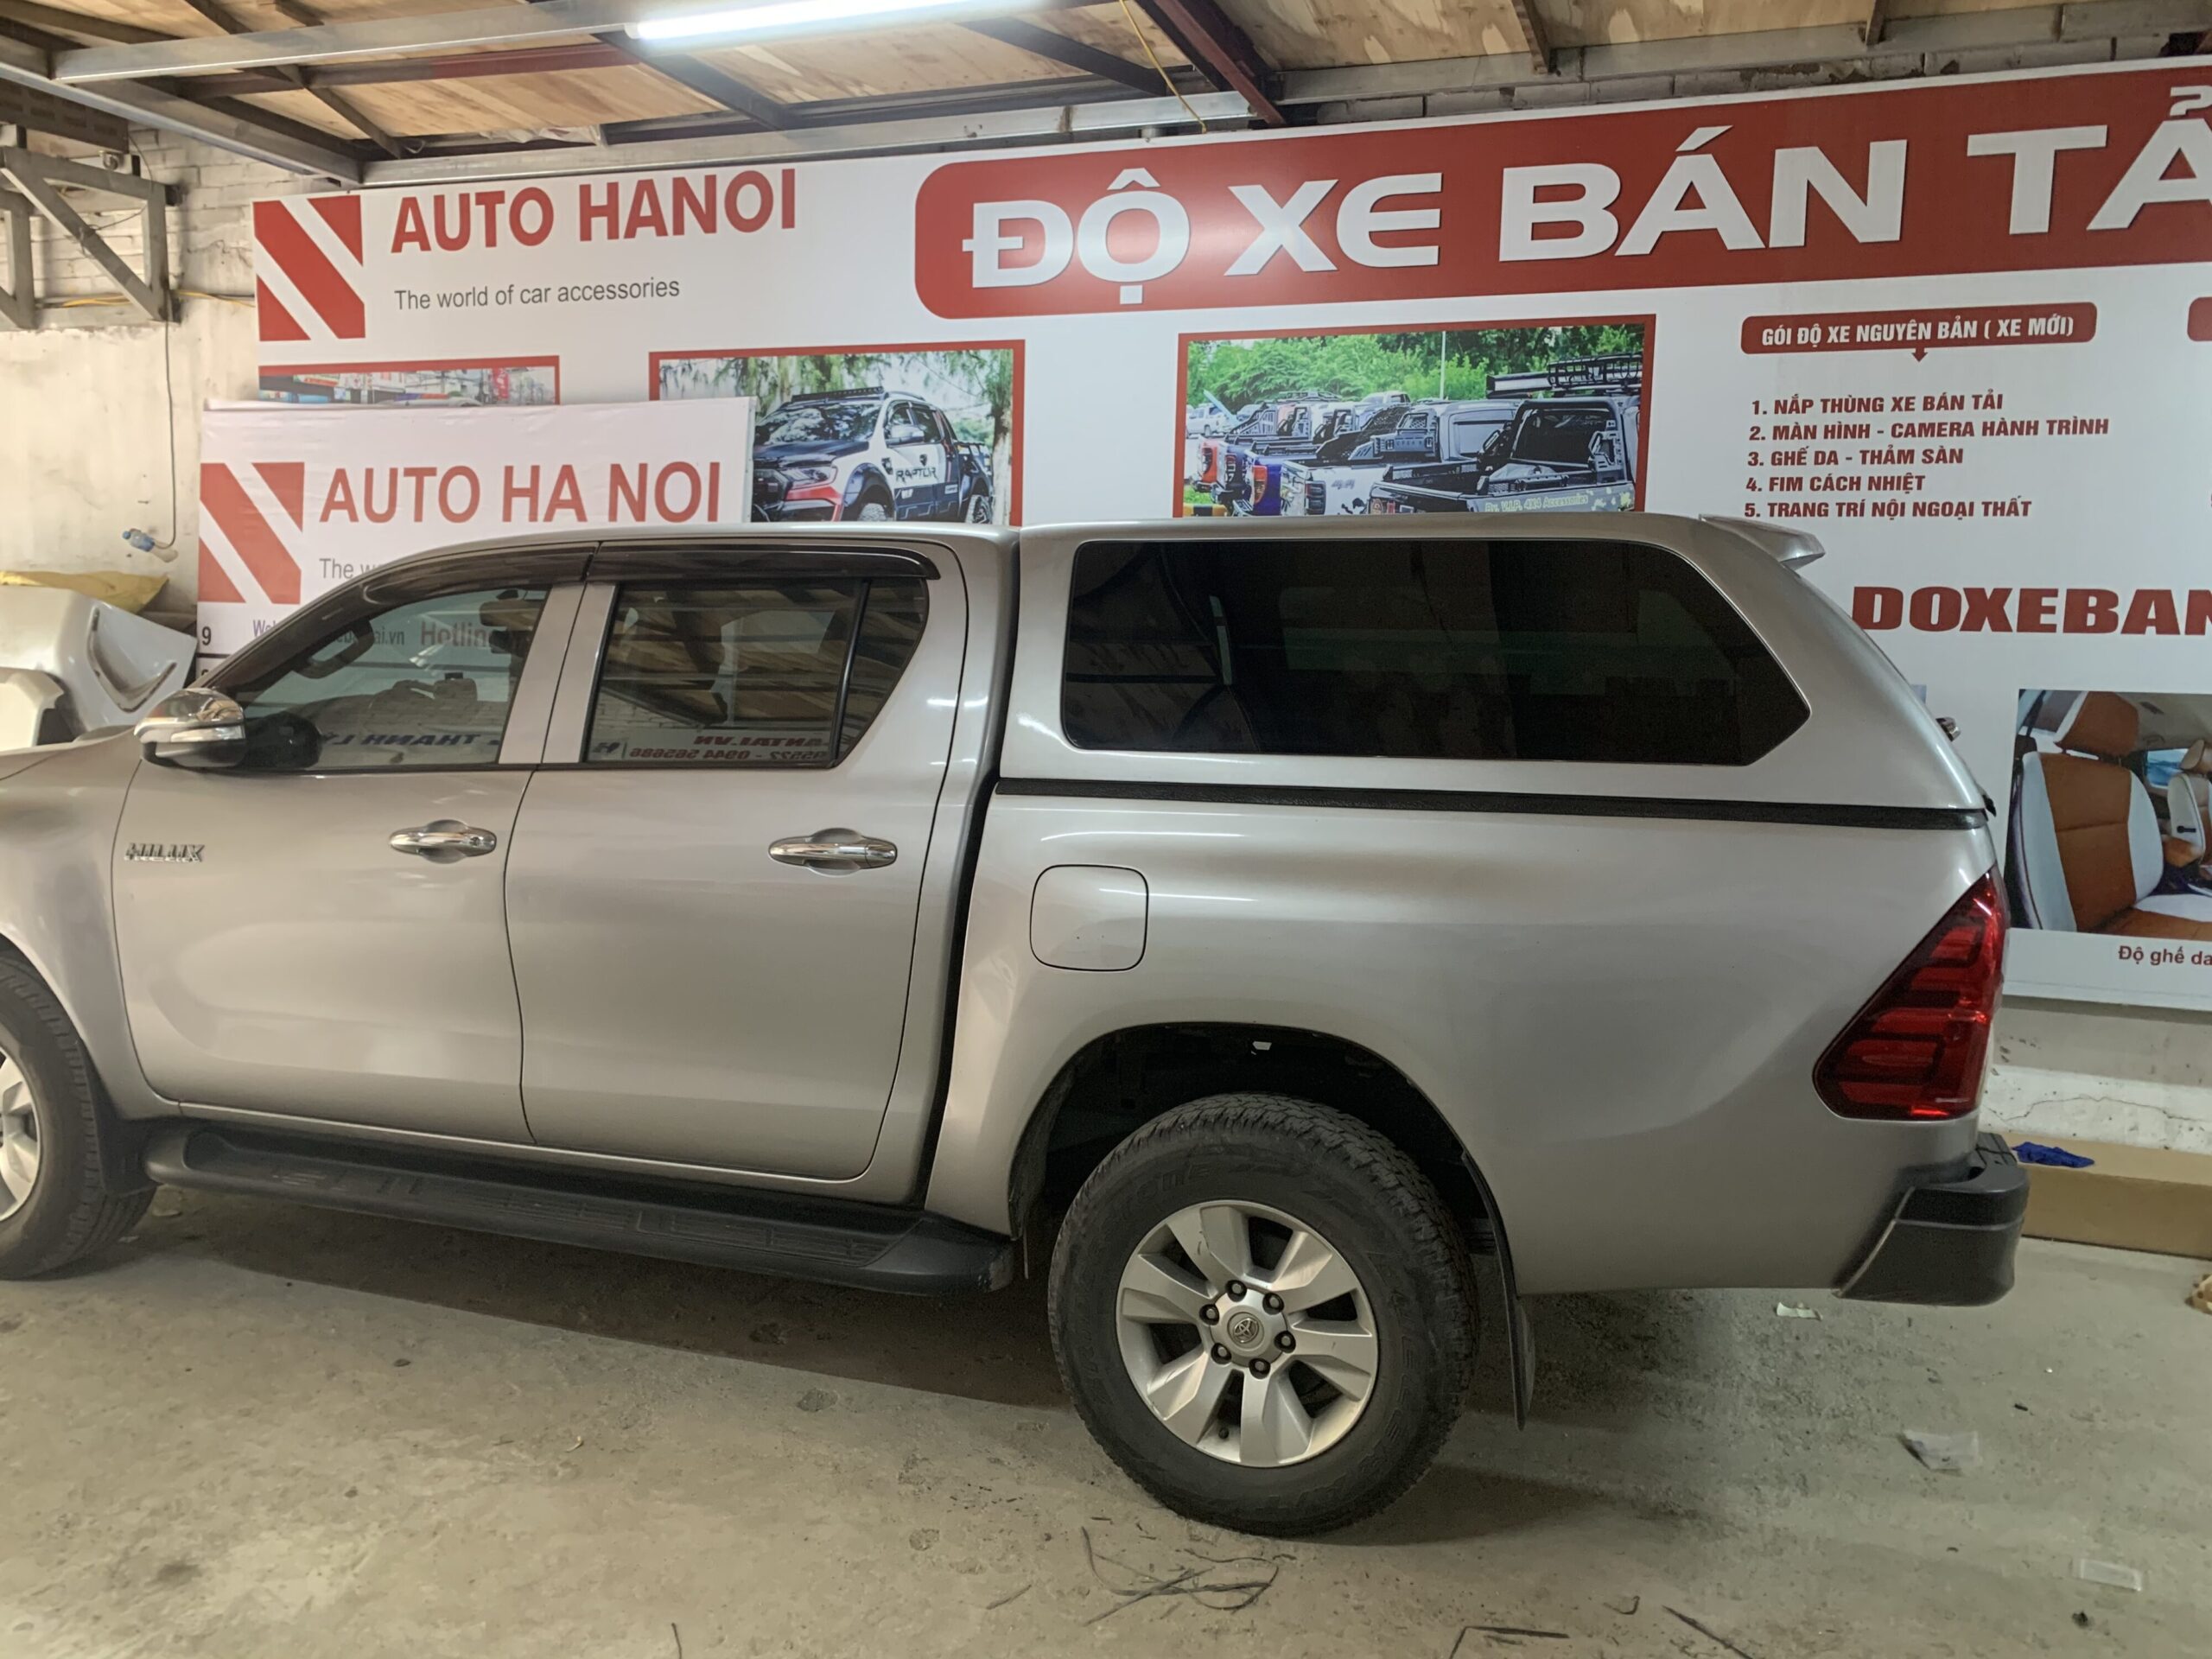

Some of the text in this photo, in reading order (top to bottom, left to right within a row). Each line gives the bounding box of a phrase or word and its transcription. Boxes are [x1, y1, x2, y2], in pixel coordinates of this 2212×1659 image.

[390, 168, 796, 255] AUTO HANOI
[962, 168, 1191, 304] ĐỘ
[1224, 173, 1442, 276] XE
[1499, 125, 1907, 262] BÁN
[395, 276, 680, 310] The world of car accessories
[1762, 324, 1791, 346] GÓI
[1797, 325, 1821, 347] ĐỘ
[1827, 326, 1850, 343] XE
[1856, 320, 1932, 342] NGUYÊN
[1937, 315, 1978, 340] BẢN
[1997, 319, 2021, 337] XE
[1751, 389, 2004, 415] 1. NẮP THÙNG XE BÁN TẢI
[1749, 426, 1766, 442] 2.
[1772, 422, 1817, 440] MÀN
[1823, 421, 1871, 439] HÌNH
[1891, 422, 1975, 438] CAMERA
[1982, 417, 2039, 437] HÀNH
[2046, 416, 2109, 435] TRÌNH
[1748, 451, 1764, 467] 3.
[1770, 445, 1809, 466] GHẾ
[1814, 450, 1839, 465] DA
[1859, 444, 1916, 465] THẢM
[1922, 444, 1964, 464] SÀN
[319, 461, 721, 524] AUTO HA NOI
[1746, 472, 1926, 494] 4. FIM CÁCH NHIỆT
[1745, 494, 2031, 520] 5. TRANG TRÍ NỘI NGOẠI THẤT
[319, 558, 354, 579] The
[201, 626, 212, 646] 9
[2119, 945, 2212, 966] Độ ghế da
